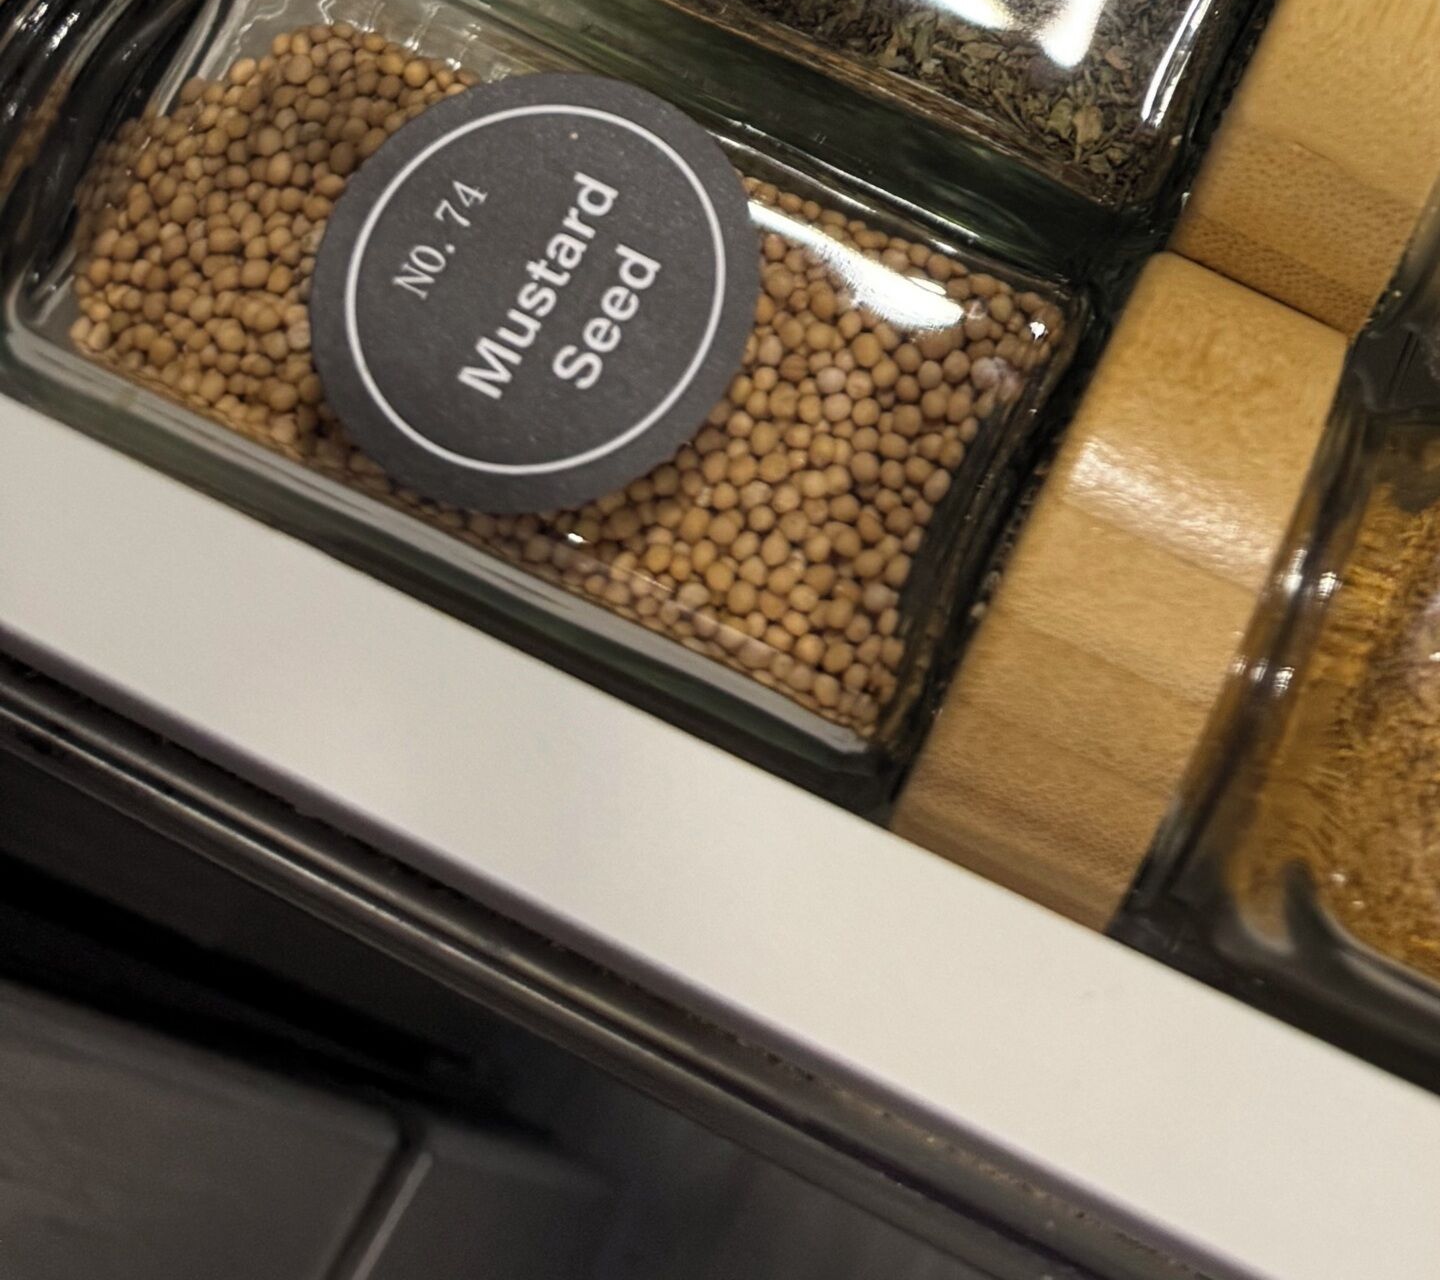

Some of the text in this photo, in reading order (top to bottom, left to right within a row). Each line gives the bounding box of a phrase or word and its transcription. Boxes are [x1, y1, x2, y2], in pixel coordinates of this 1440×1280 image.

[392, 180, 488, 299] NO. 74
[457, 171, 619, 399] Mustard
[552, 244, 662, 389] Seed
